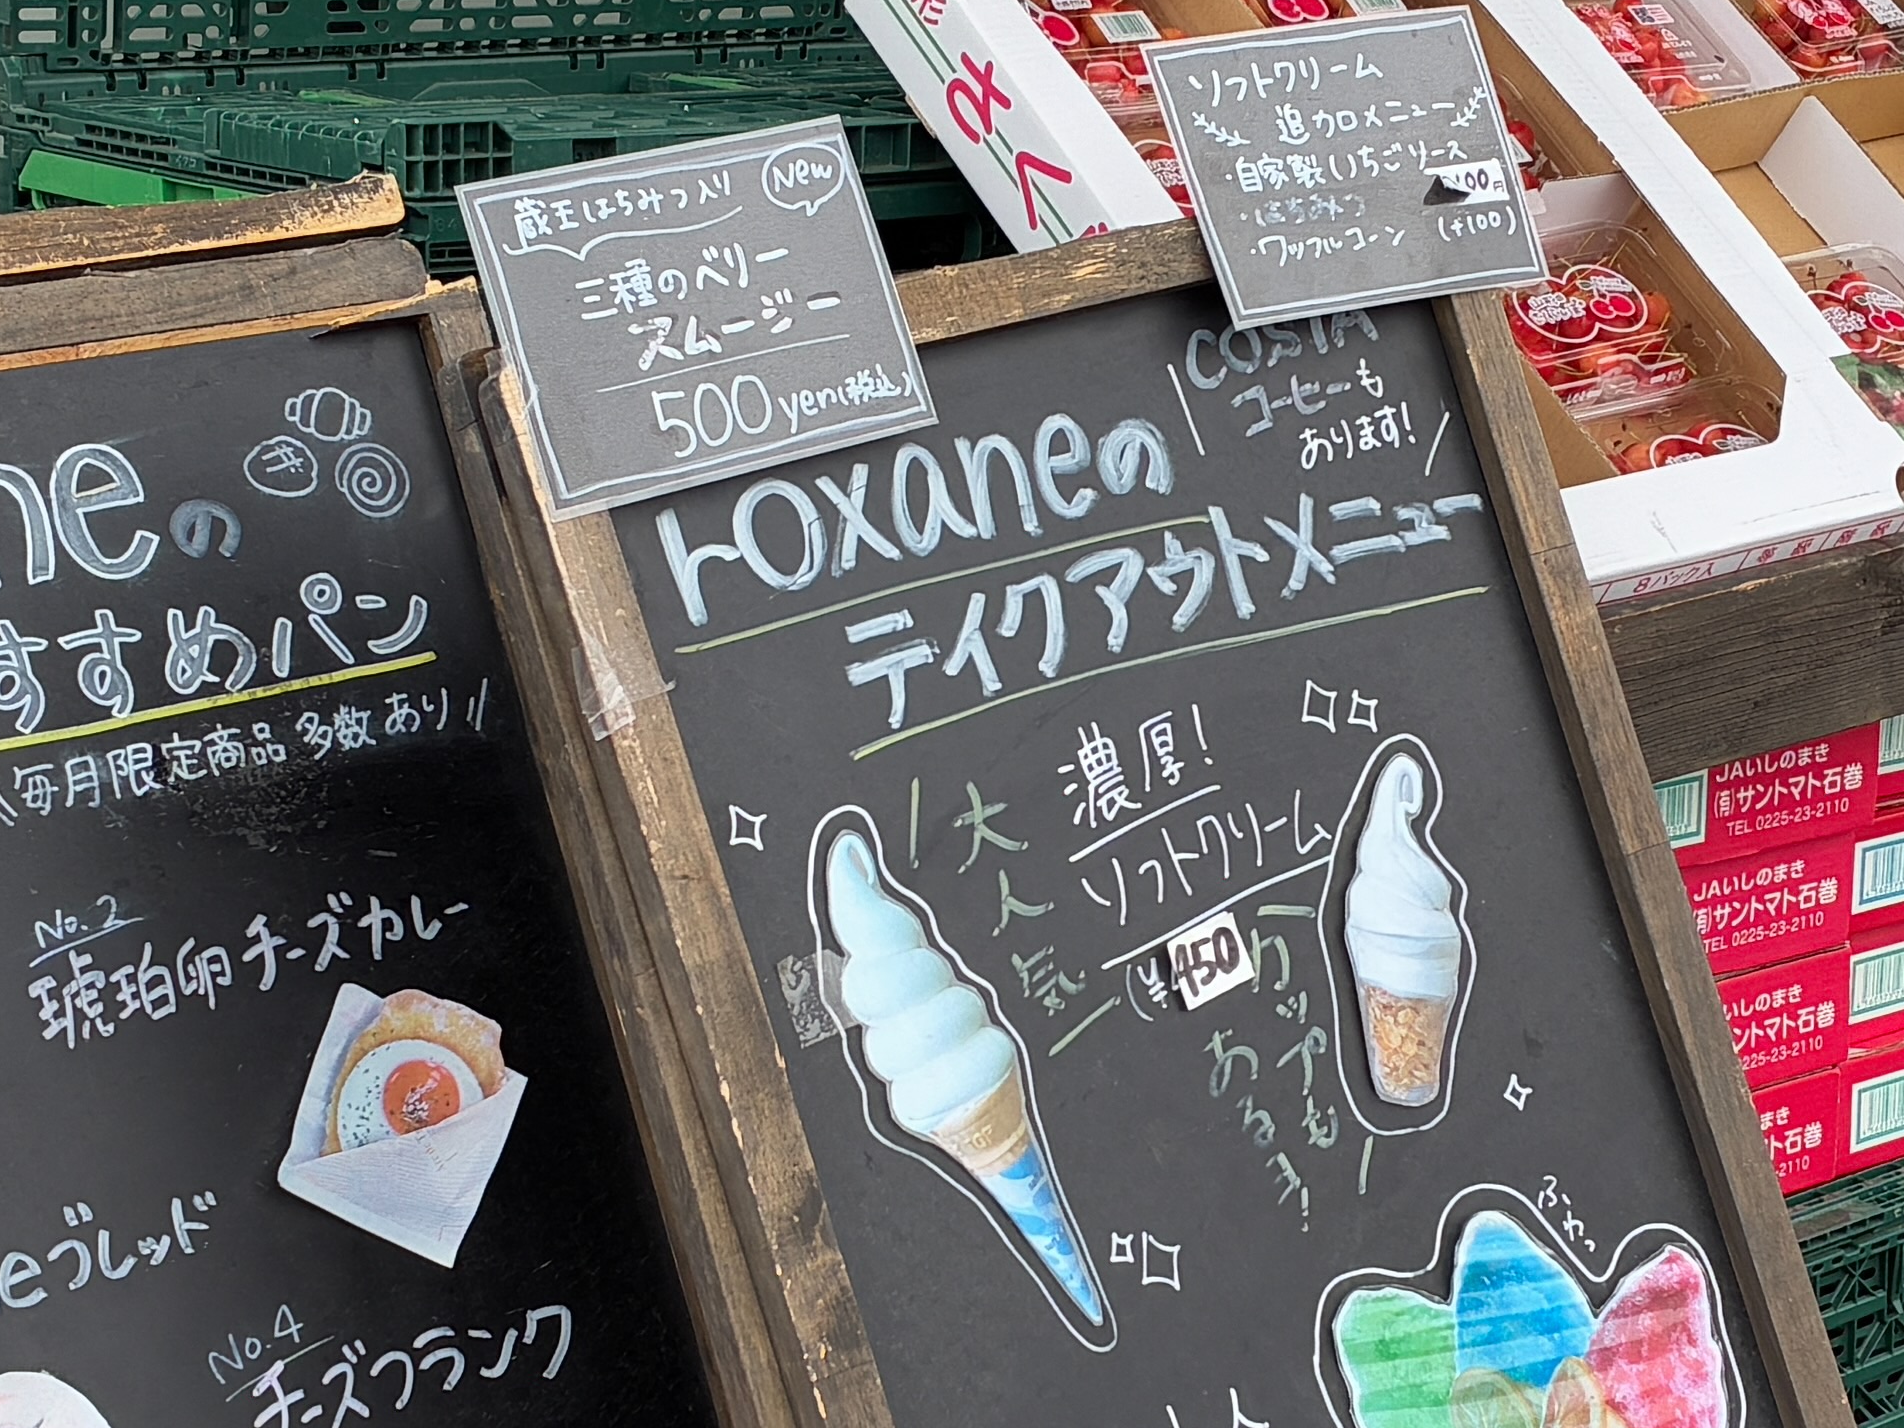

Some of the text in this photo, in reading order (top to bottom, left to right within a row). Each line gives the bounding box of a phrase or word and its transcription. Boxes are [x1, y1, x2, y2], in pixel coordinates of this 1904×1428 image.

[1189, 52, 1384, 108] ソフトクリーム
[1275, 101, 1456, 146] 追加メニュー
[512, 169, 733, 240] 蔵王はちみつ入り
[771, 162, 834, 196] New
[1437, 205, 1517, 242] (+100)
[575, 242, 790, 320] 三種のベリー
[627, 288, 842, 371] スムージー
[1230, 358, 1386, 438] コーヒーも
[1299, 401, 1418, 473] あります!
[656, 412, 1177, 628] roxaneの
[844, 492, 1484, 729] テイクアウトメニュー
[1058, 704, 1214, 829] 濃厚!
[1714, 742, 1831, 784] JAいしのまき
[1726, 796, 1850, 837] TEL 0225-23-2110
[1083, 789, 1334, 926] ソフトクリーム
[1693, 858, 1807, 900] JAいしのまき
[34, 893, 122, 951] No.2
[1703, 911, 1826, 953] TEL 0225-23-2110
[207, 1302, 304, 1386] No.4
